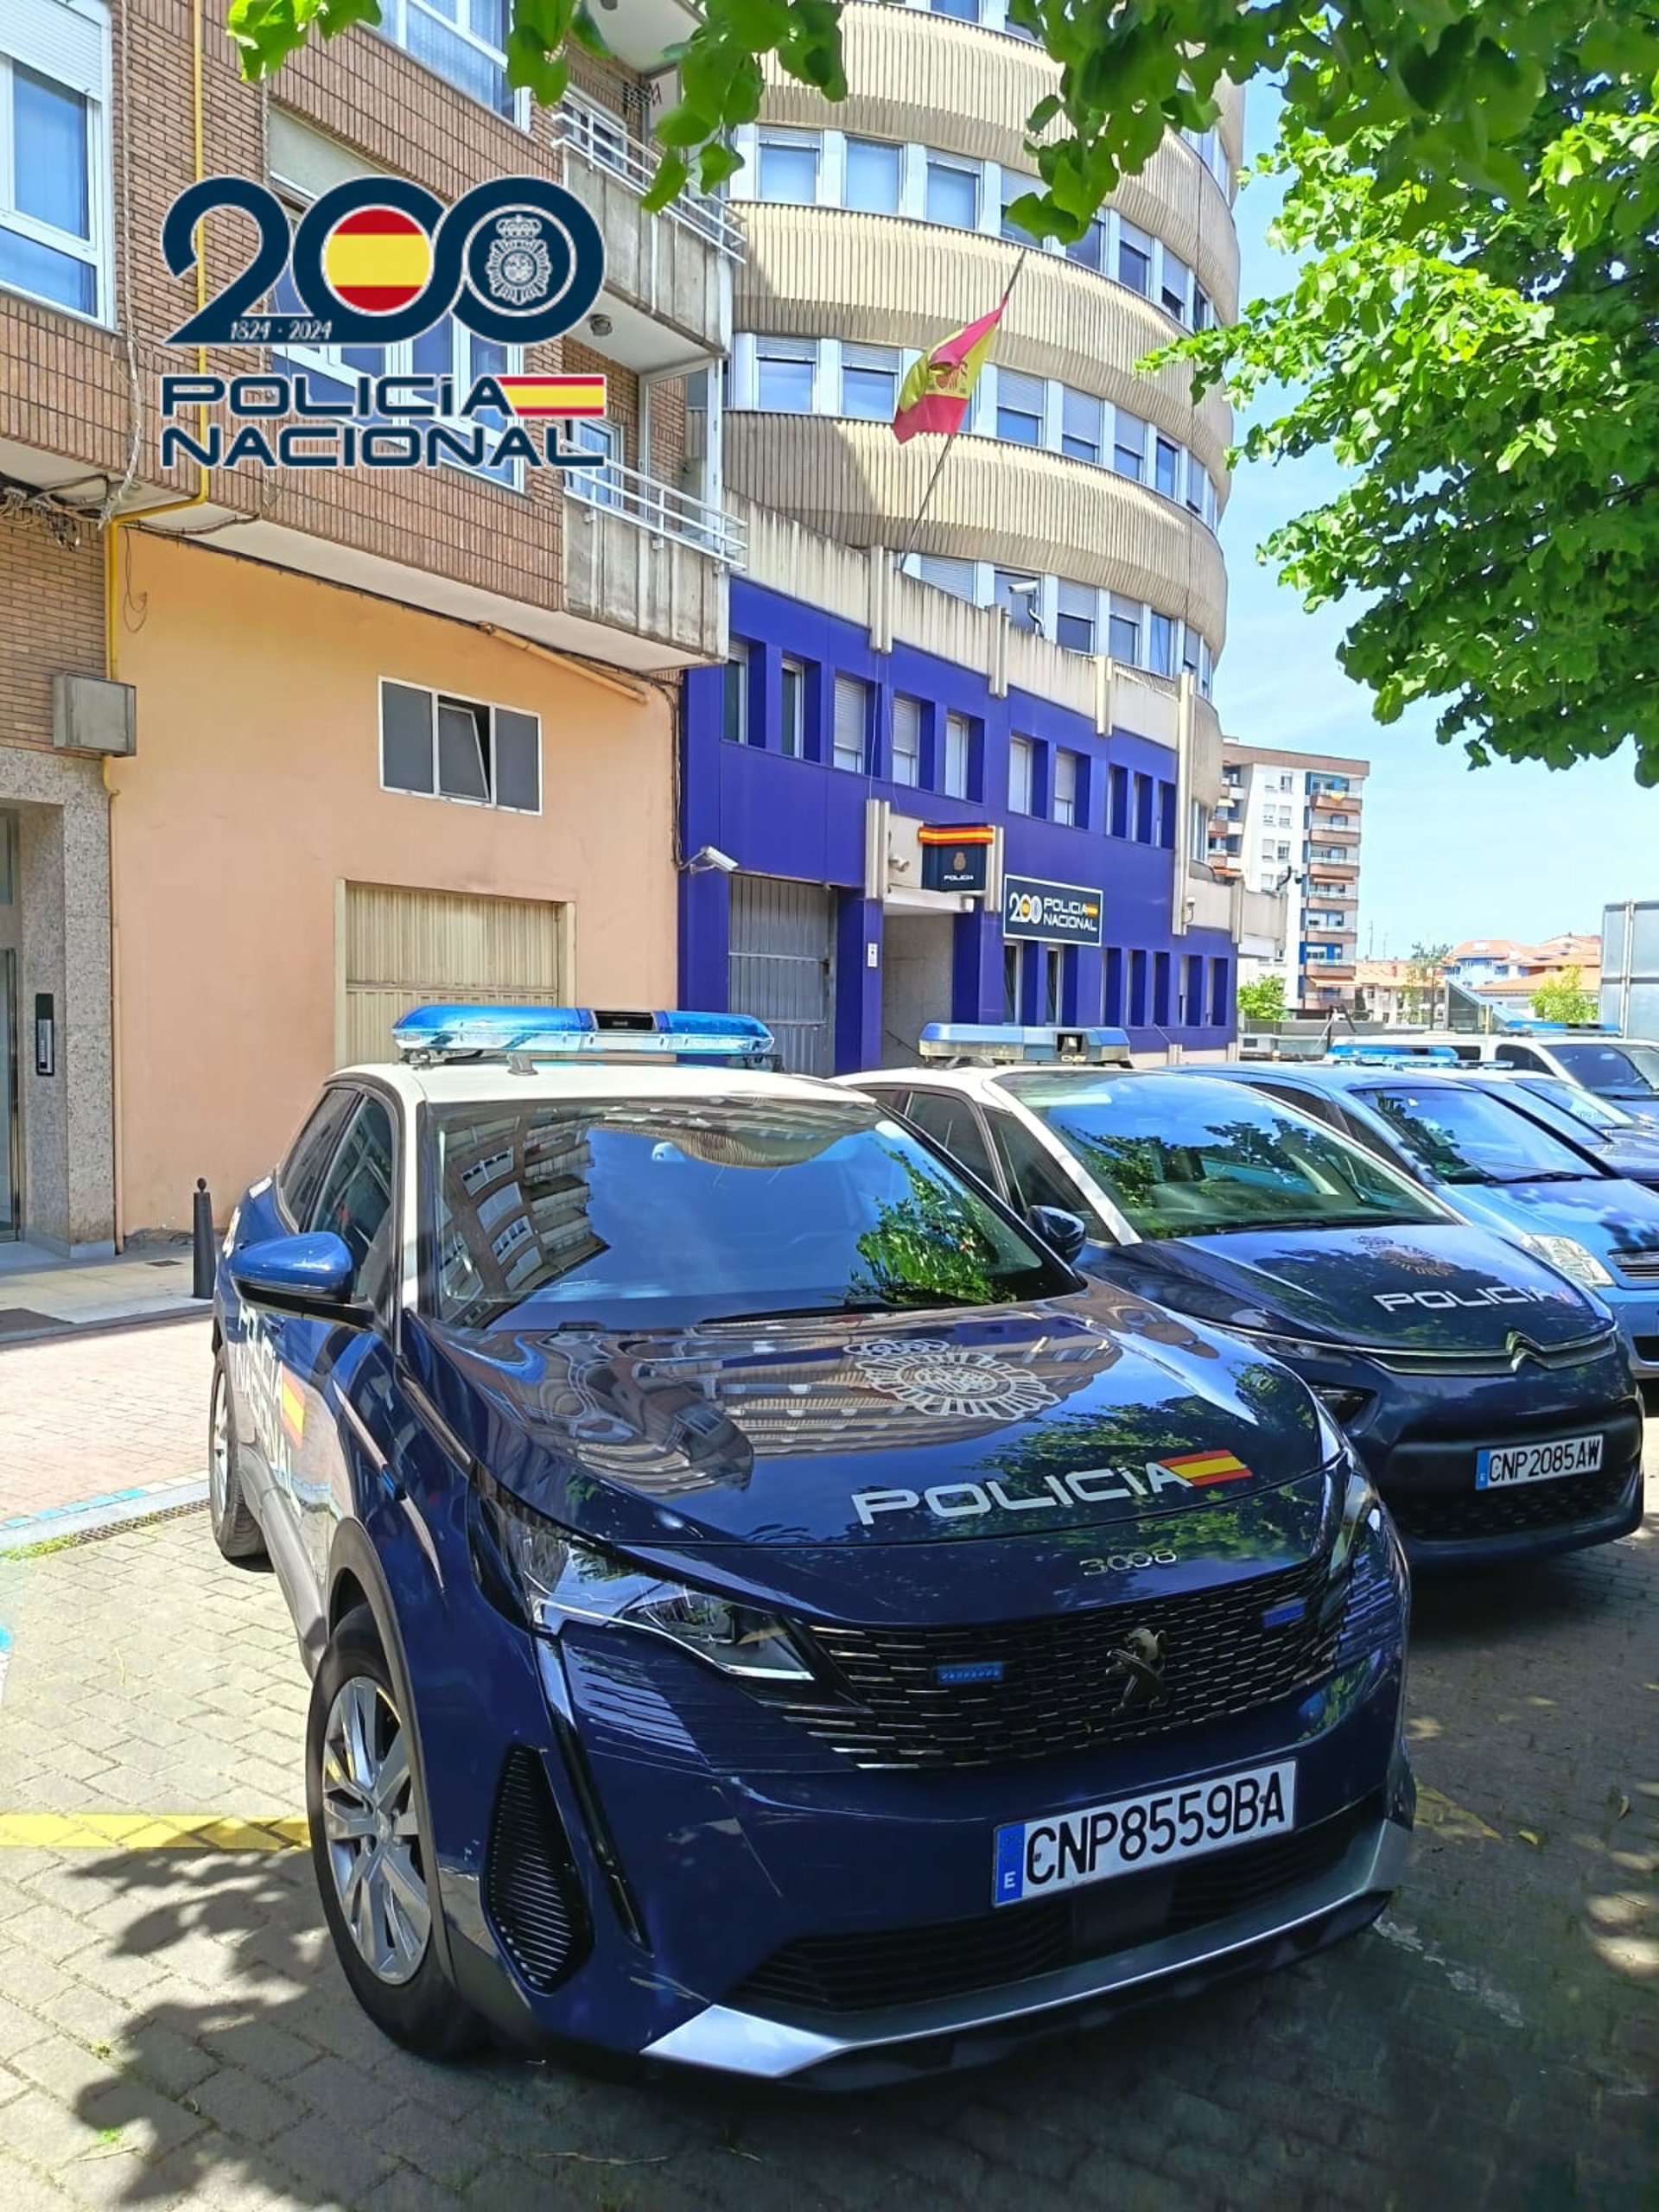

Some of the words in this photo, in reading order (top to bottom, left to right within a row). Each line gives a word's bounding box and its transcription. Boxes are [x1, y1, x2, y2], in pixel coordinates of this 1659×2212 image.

[1009, 892, 1043, 925] 200
[1043, 912, 1098, 932] NACIONAL
[1489, 1440, 1600, 1483] CNP2085AW
[1079, 1548, 1178, 1577] 3008
[1003, 1870, 1017, 1890] E
[1026, 1771, 1286, 1885] CNP8559BA
